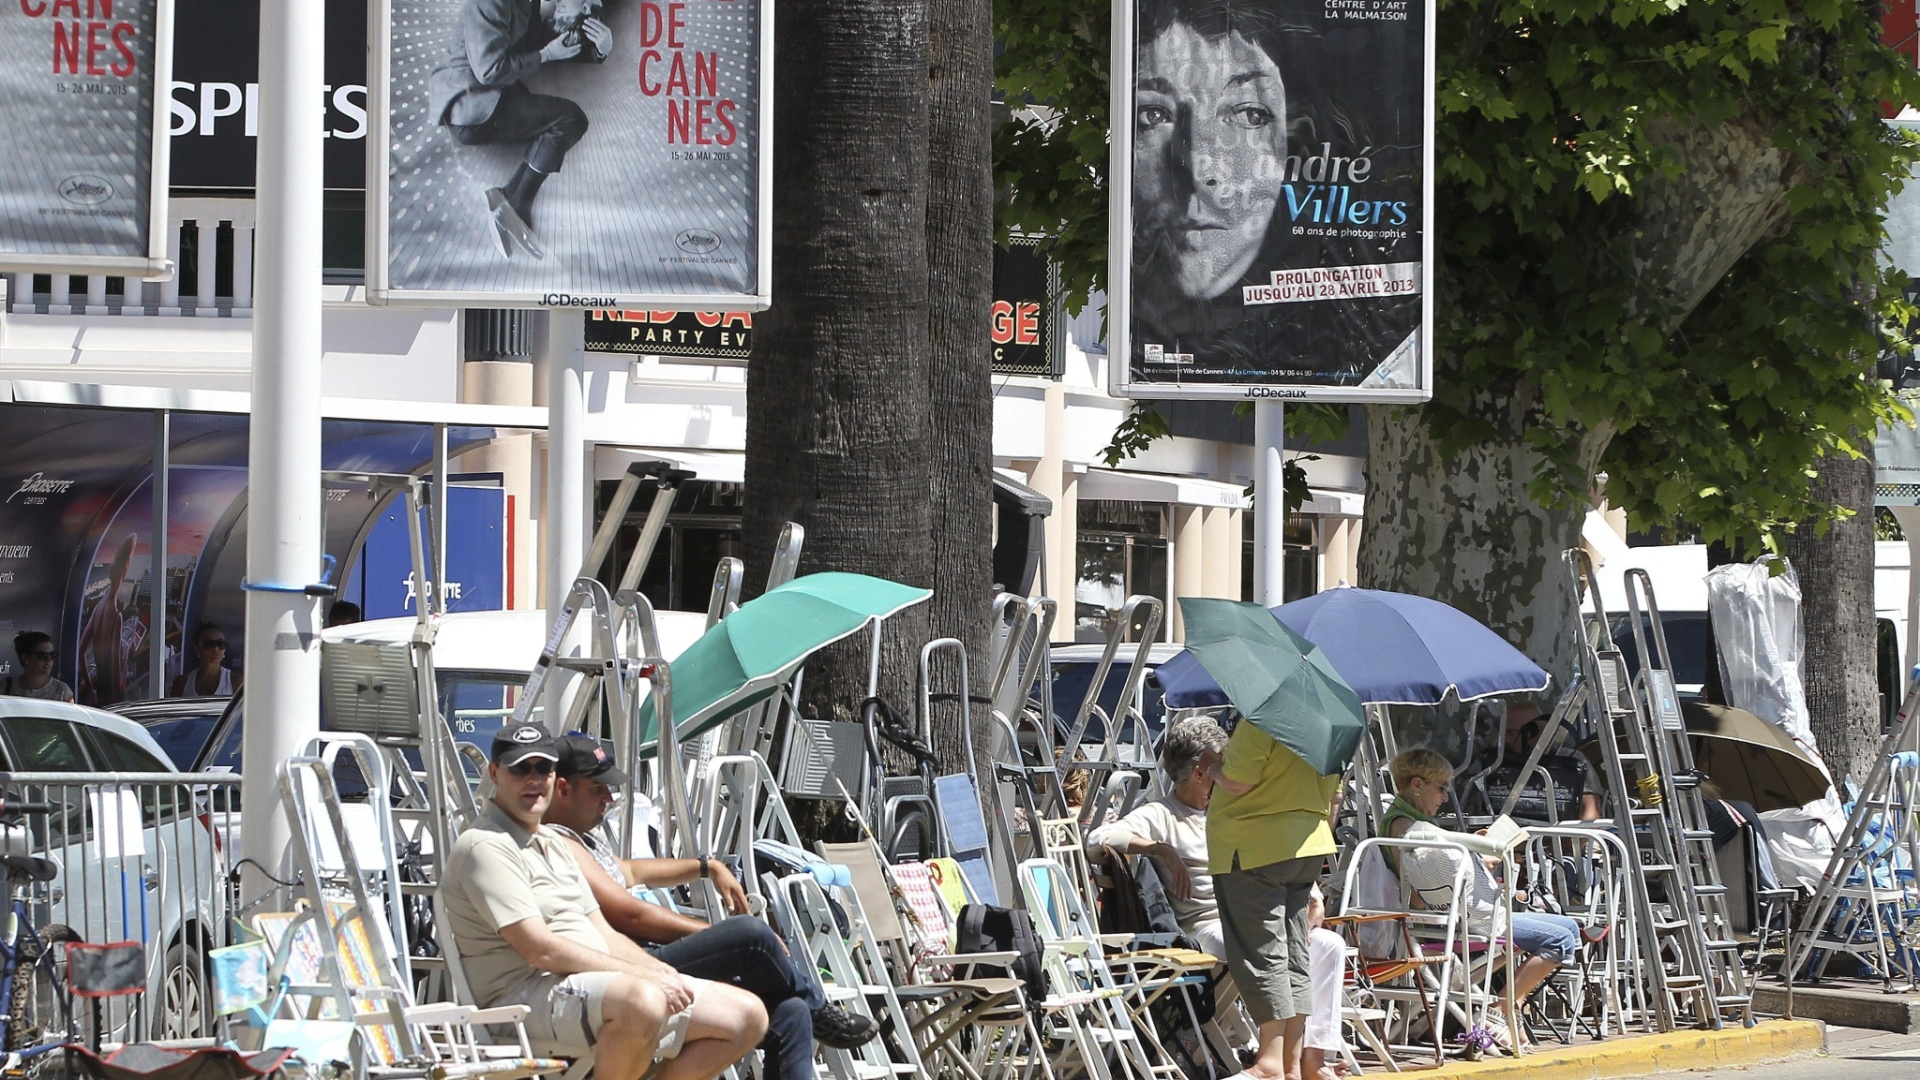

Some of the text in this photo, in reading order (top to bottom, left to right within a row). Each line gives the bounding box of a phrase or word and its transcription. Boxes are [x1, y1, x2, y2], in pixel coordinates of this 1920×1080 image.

[1324, 0, 1407, 10] CENTRE D'ART
[1325, 10, 1407, 20] LA MALMAISON
[640, 3, 685, 48] DE
[52, 22, 135, 77] NES
[639, 50, 717, 97] CAN
[86, 84, 103, 95] MAI
[107, 84, 127, 95] 2013
[668, 99, 737, 146] NES
[696, 152, 711, 161] MAI
[713, 152, 731, 161] 2013
[1280, 184, 1407, 225] Villers
[1292, 226, 1407, 240] 60 ans de photographie
[1276, 267, 1382, 286] PROLONGATION
[1246, 279, 1414, 302] JUSQU'AU 28 AVRIL 2013
[537, 293, 617, 307] JCDecaux
[631, 327, 704, 344] PARTY
[1183, 367, 1195, 375] Ville
[1244, 387, 1307, 399] JCDecaux
